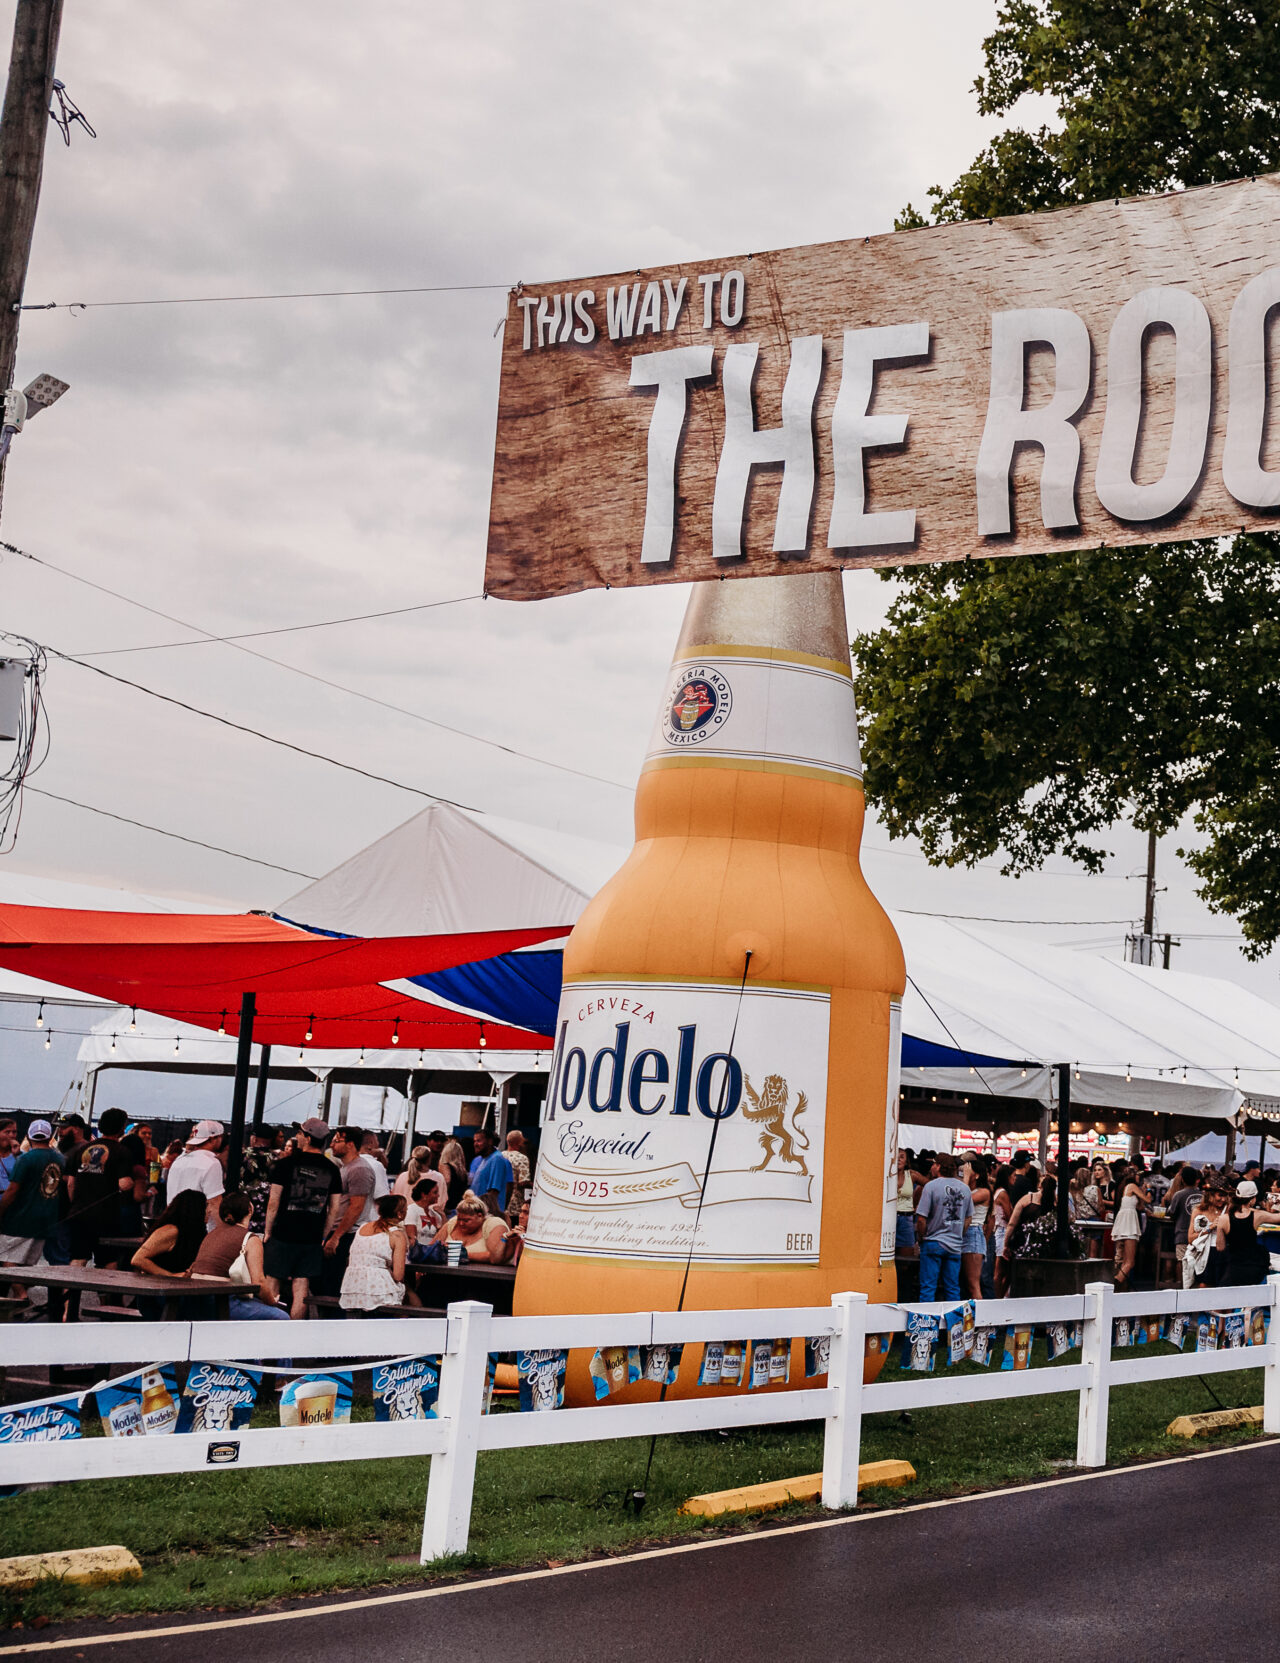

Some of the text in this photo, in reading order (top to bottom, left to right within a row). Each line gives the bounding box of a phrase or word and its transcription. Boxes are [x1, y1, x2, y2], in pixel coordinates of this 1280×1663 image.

[517, 269, 745, 350] THIS WAY TO
[628, 321, 930, 564] THE
[710, 674, 729, 724] MODELO
[667, 730, 707, 743] MEXICO
[578, 997, 656, 1024] CERVEZA
[548, 1020, 743, 1120] odelo
[557, 1120, 652, 1164] Especial
[572, 1181, 609, 1198] 1925
[572, 1215, 594, 1226] and
[594, 1217, 633, 1232] quality
[577, 1230, 601, 1244] long
[602, 1231, 642, 1246] lasting
[647, 1236, 710, 1248] tradition.
[786, 1233, 813, 1251] BEER
[190, 1365, 250, 1388] Salud to
[376, 1361, 416, 1390] Salud
[193, 1384, 253, 1407] Summer
[383, 1373, 435, 1404] Summer
[0, 1406, 50, 1442] Salud
[147, 1409, 173, 1426] Modelo
[301, 1409, 332, 1424] Modelo
